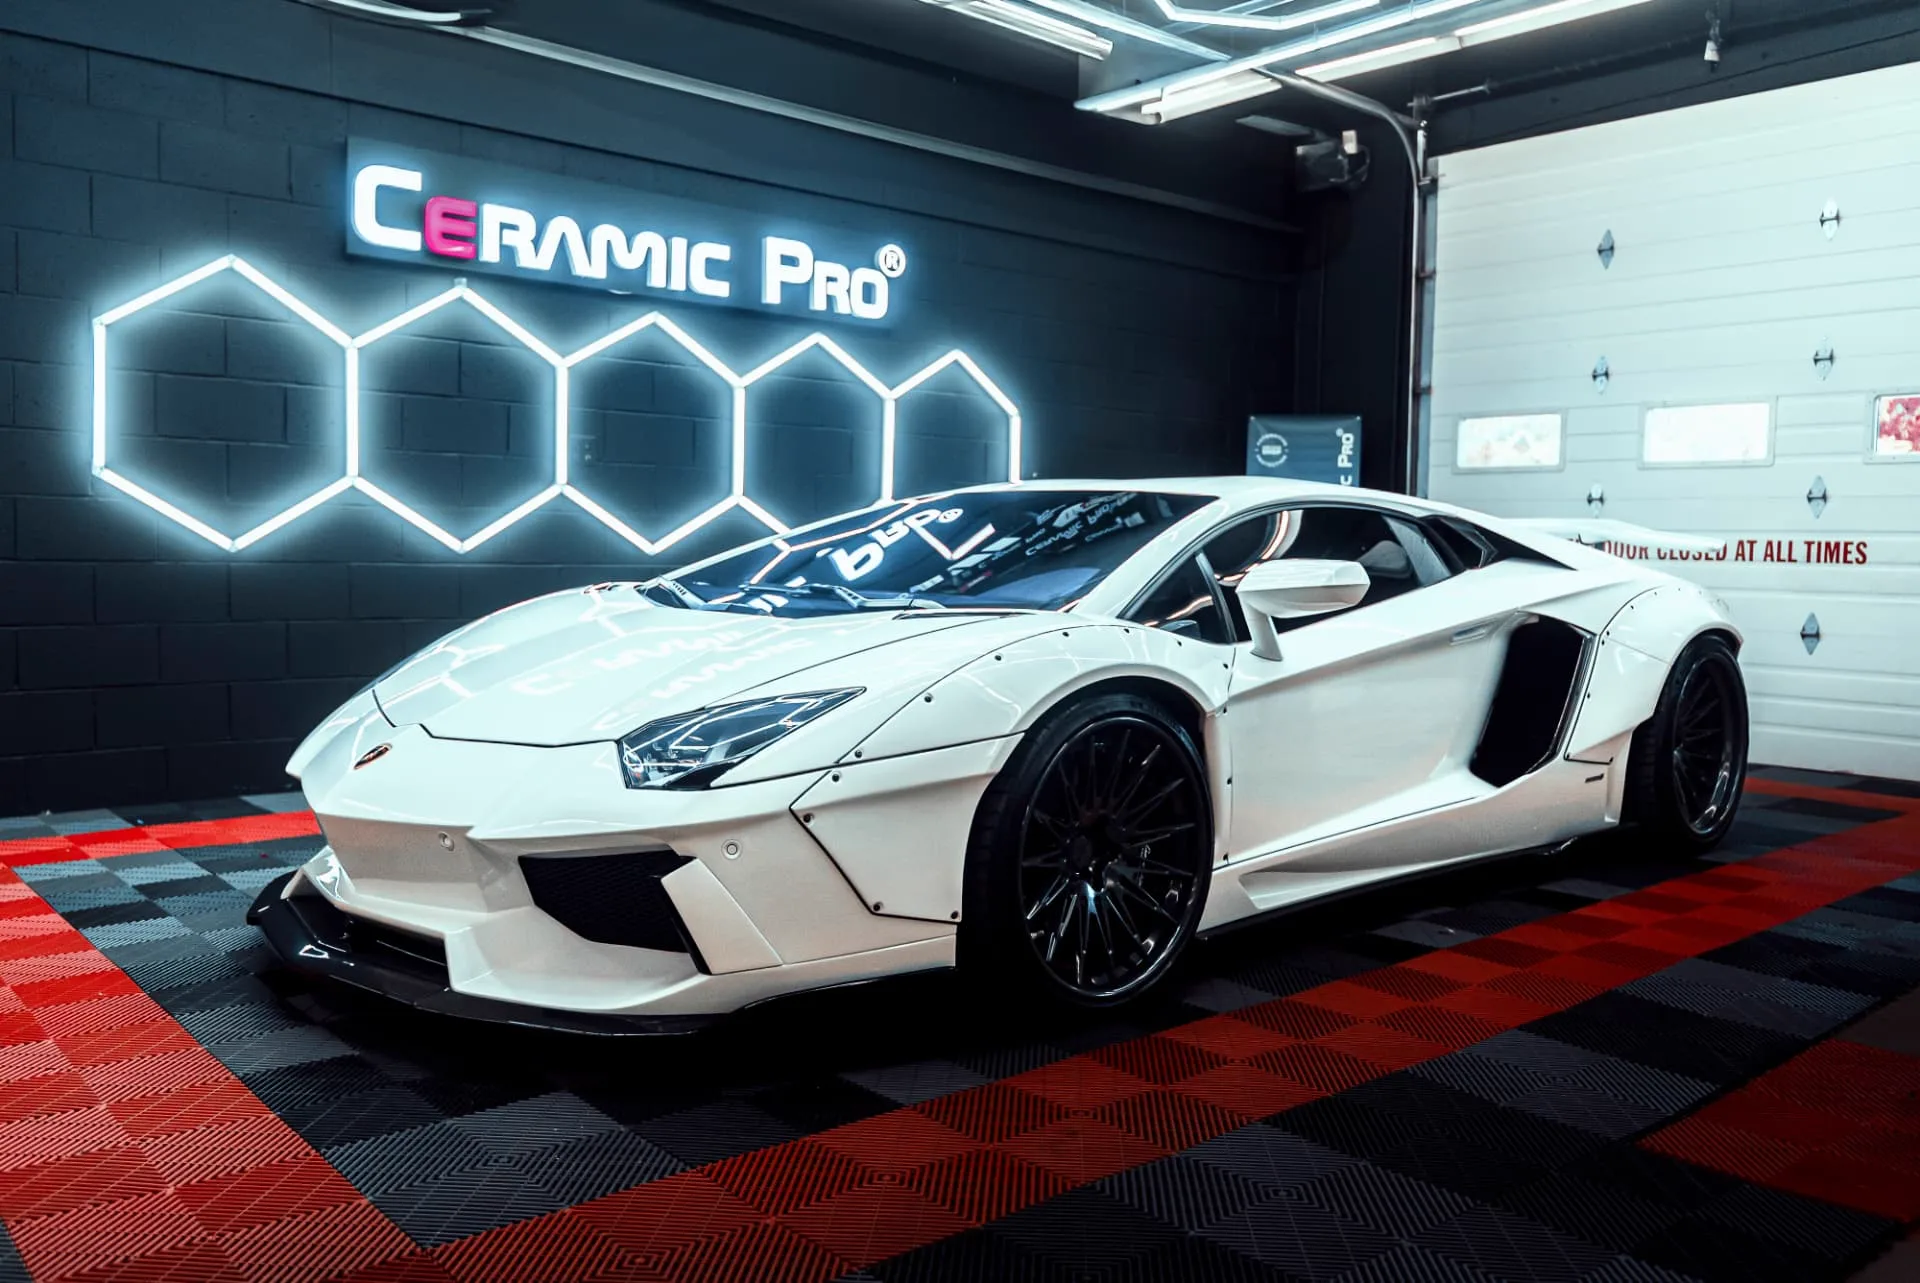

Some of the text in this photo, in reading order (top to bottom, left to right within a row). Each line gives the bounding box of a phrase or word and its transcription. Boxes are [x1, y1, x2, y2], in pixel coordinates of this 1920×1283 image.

[1734, 540, 1758, 562] AT
[1762, 540, 1798, 563] ALL
[1803, 540, 1867, 565] TIMES
